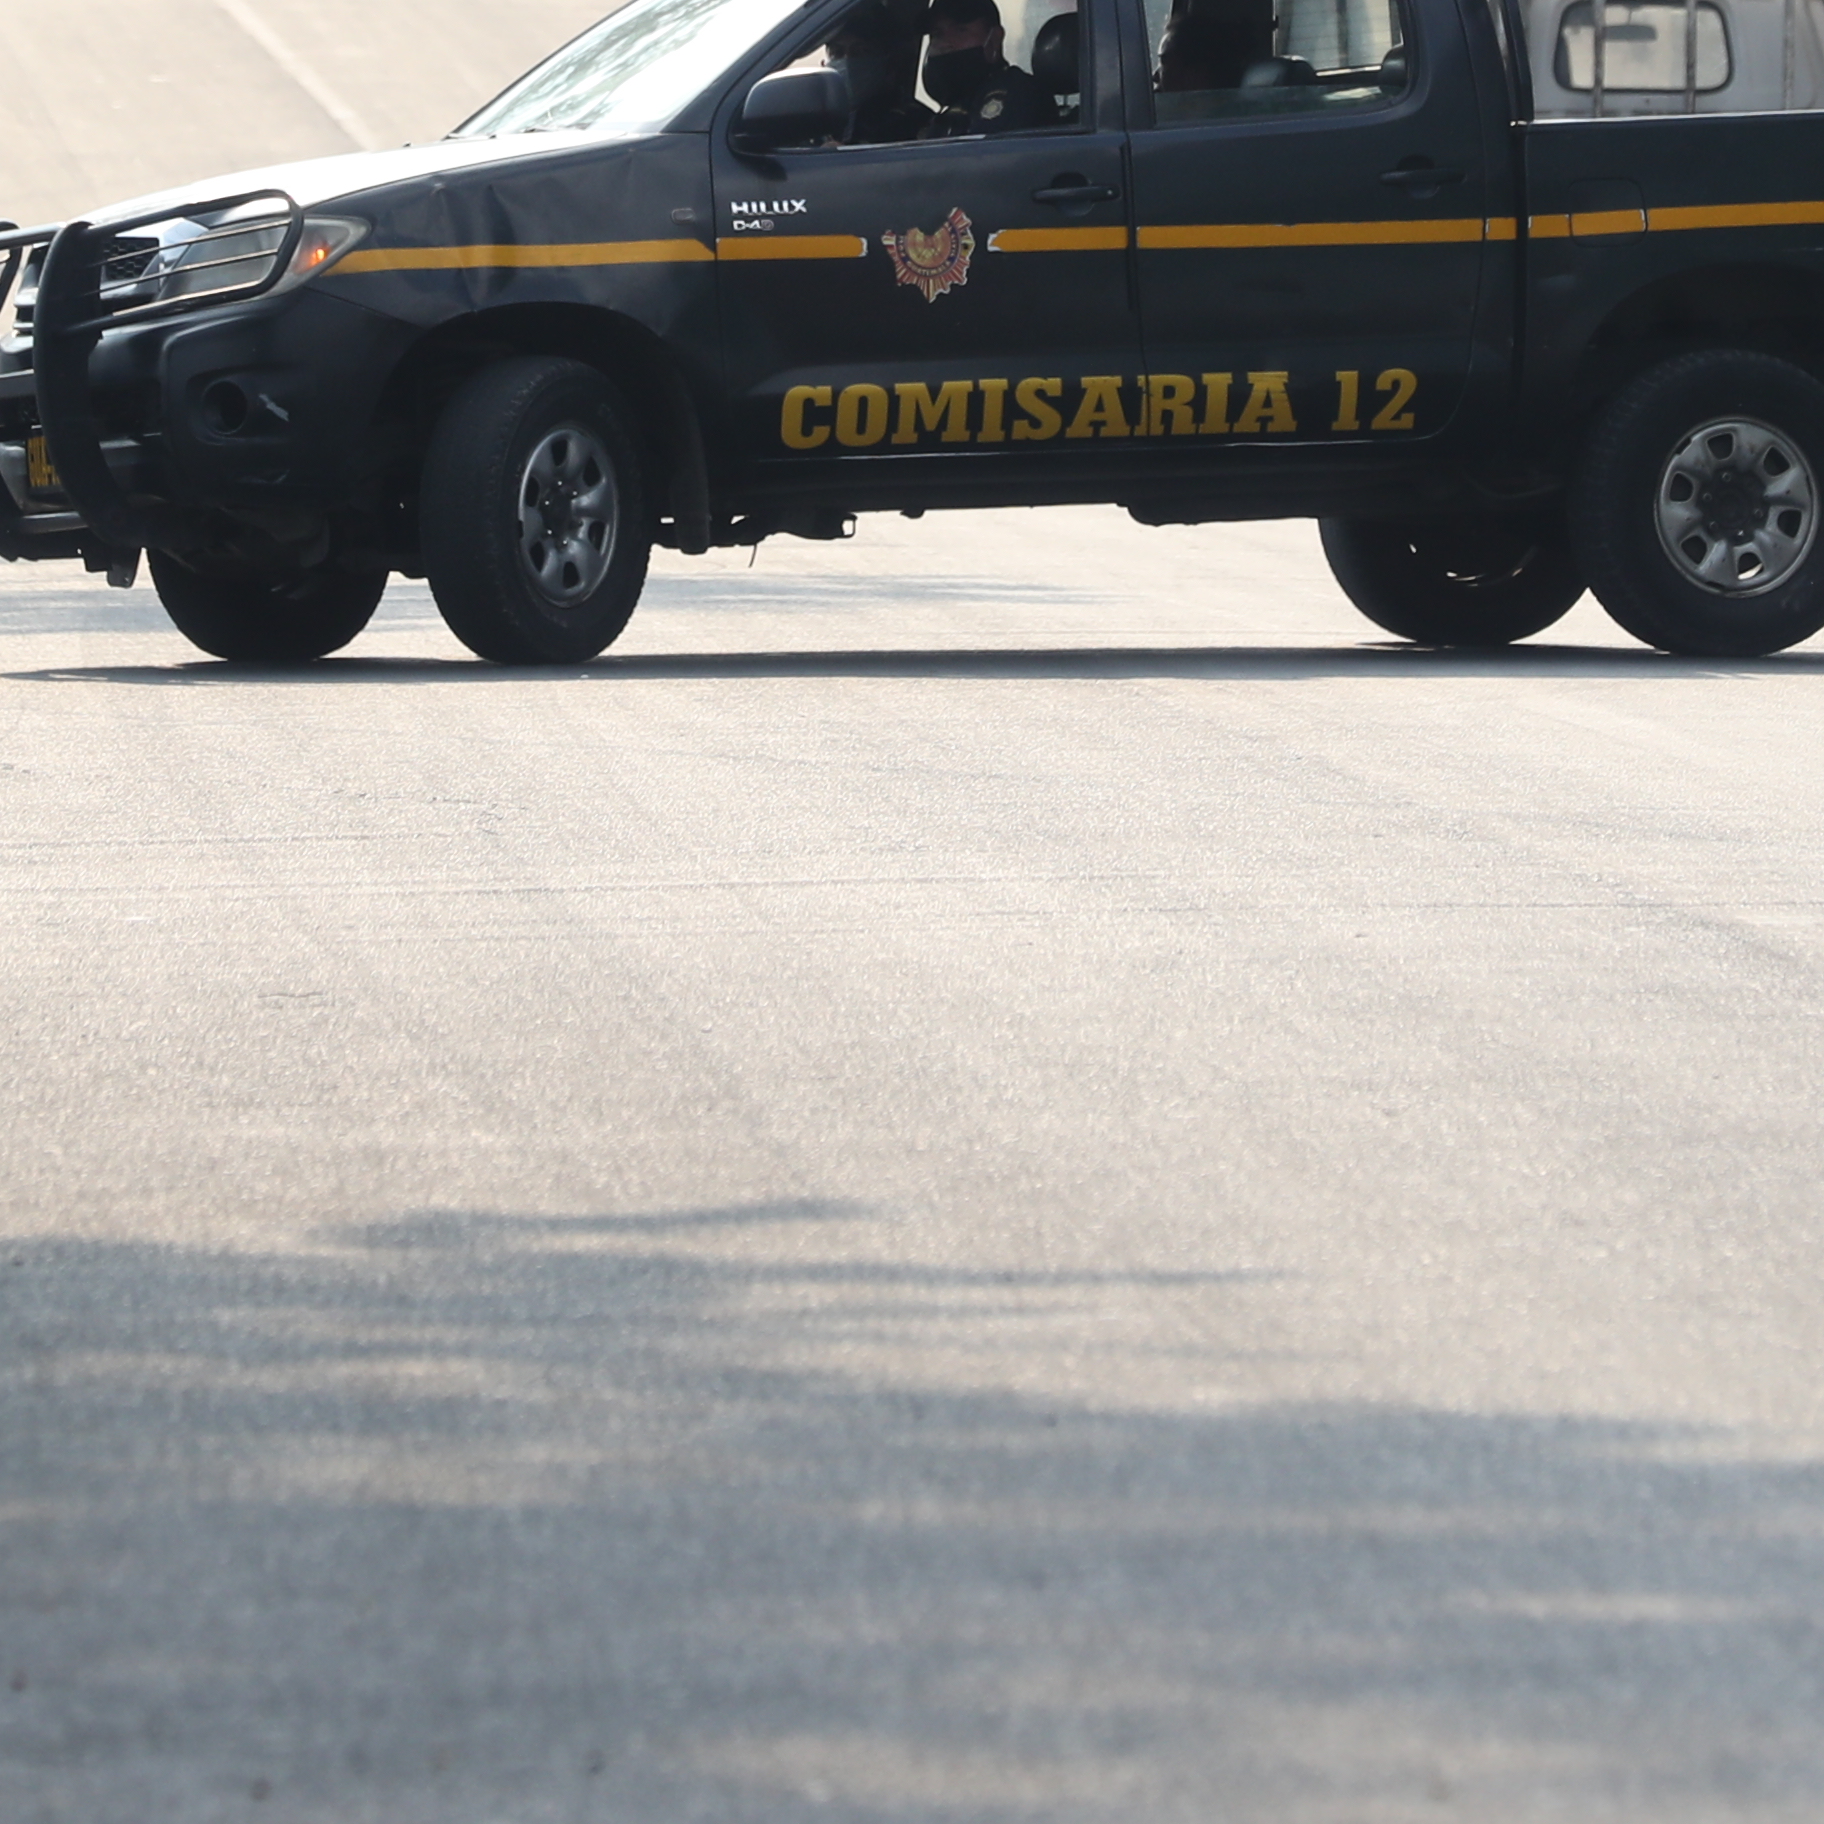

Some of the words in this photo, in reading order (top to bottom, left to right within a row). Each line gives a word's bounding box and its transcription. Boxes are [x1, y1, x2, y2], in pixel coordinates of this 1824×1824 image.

[730, 198, 808, 216] HILUX
[780, 371, 1298, 450] COMISARIA
[1331, 367, 1419, 432] 12
